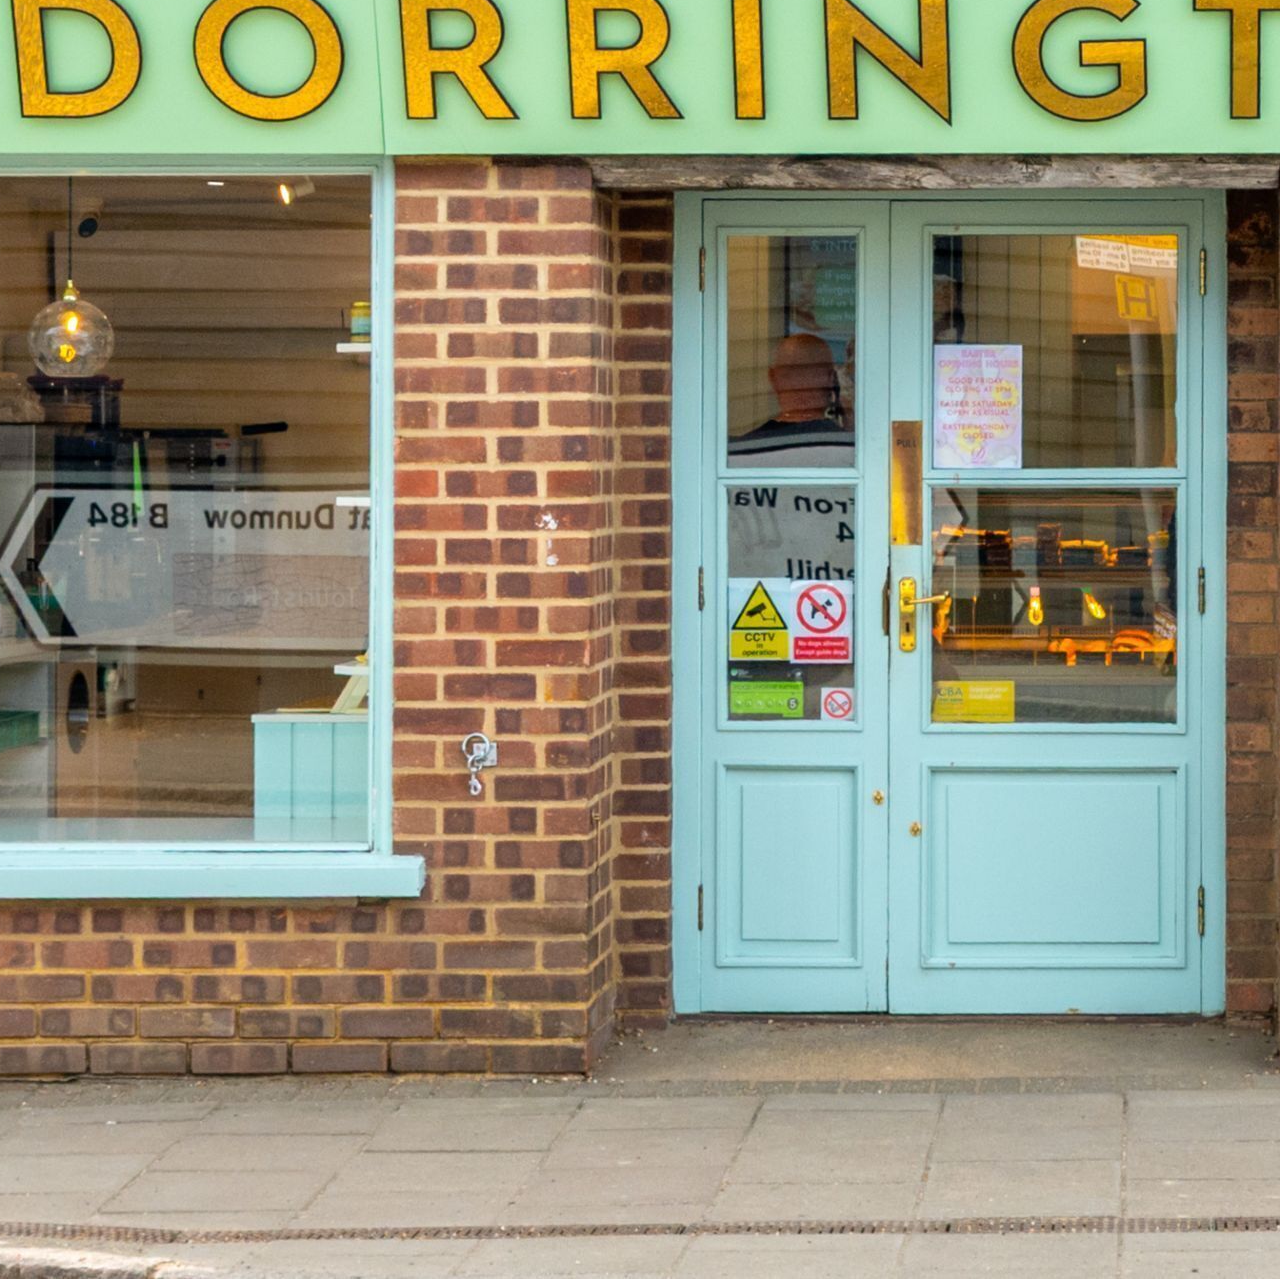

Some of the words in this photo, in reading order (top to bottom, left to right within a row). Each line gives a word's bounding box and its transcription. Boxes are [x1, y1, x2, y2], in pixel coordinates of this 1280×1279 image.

[985, 360, 1019, 368] HOURS
[948, 377, 973, 385] GOOD
[945, 385, 980, 393] CLOSING
[962, 432, 994, 440] CLOSED
[896, 439, 917, 448] PULL
[744, 632, 776, 642] CCTV
[742, 649, 778, 657] operation
